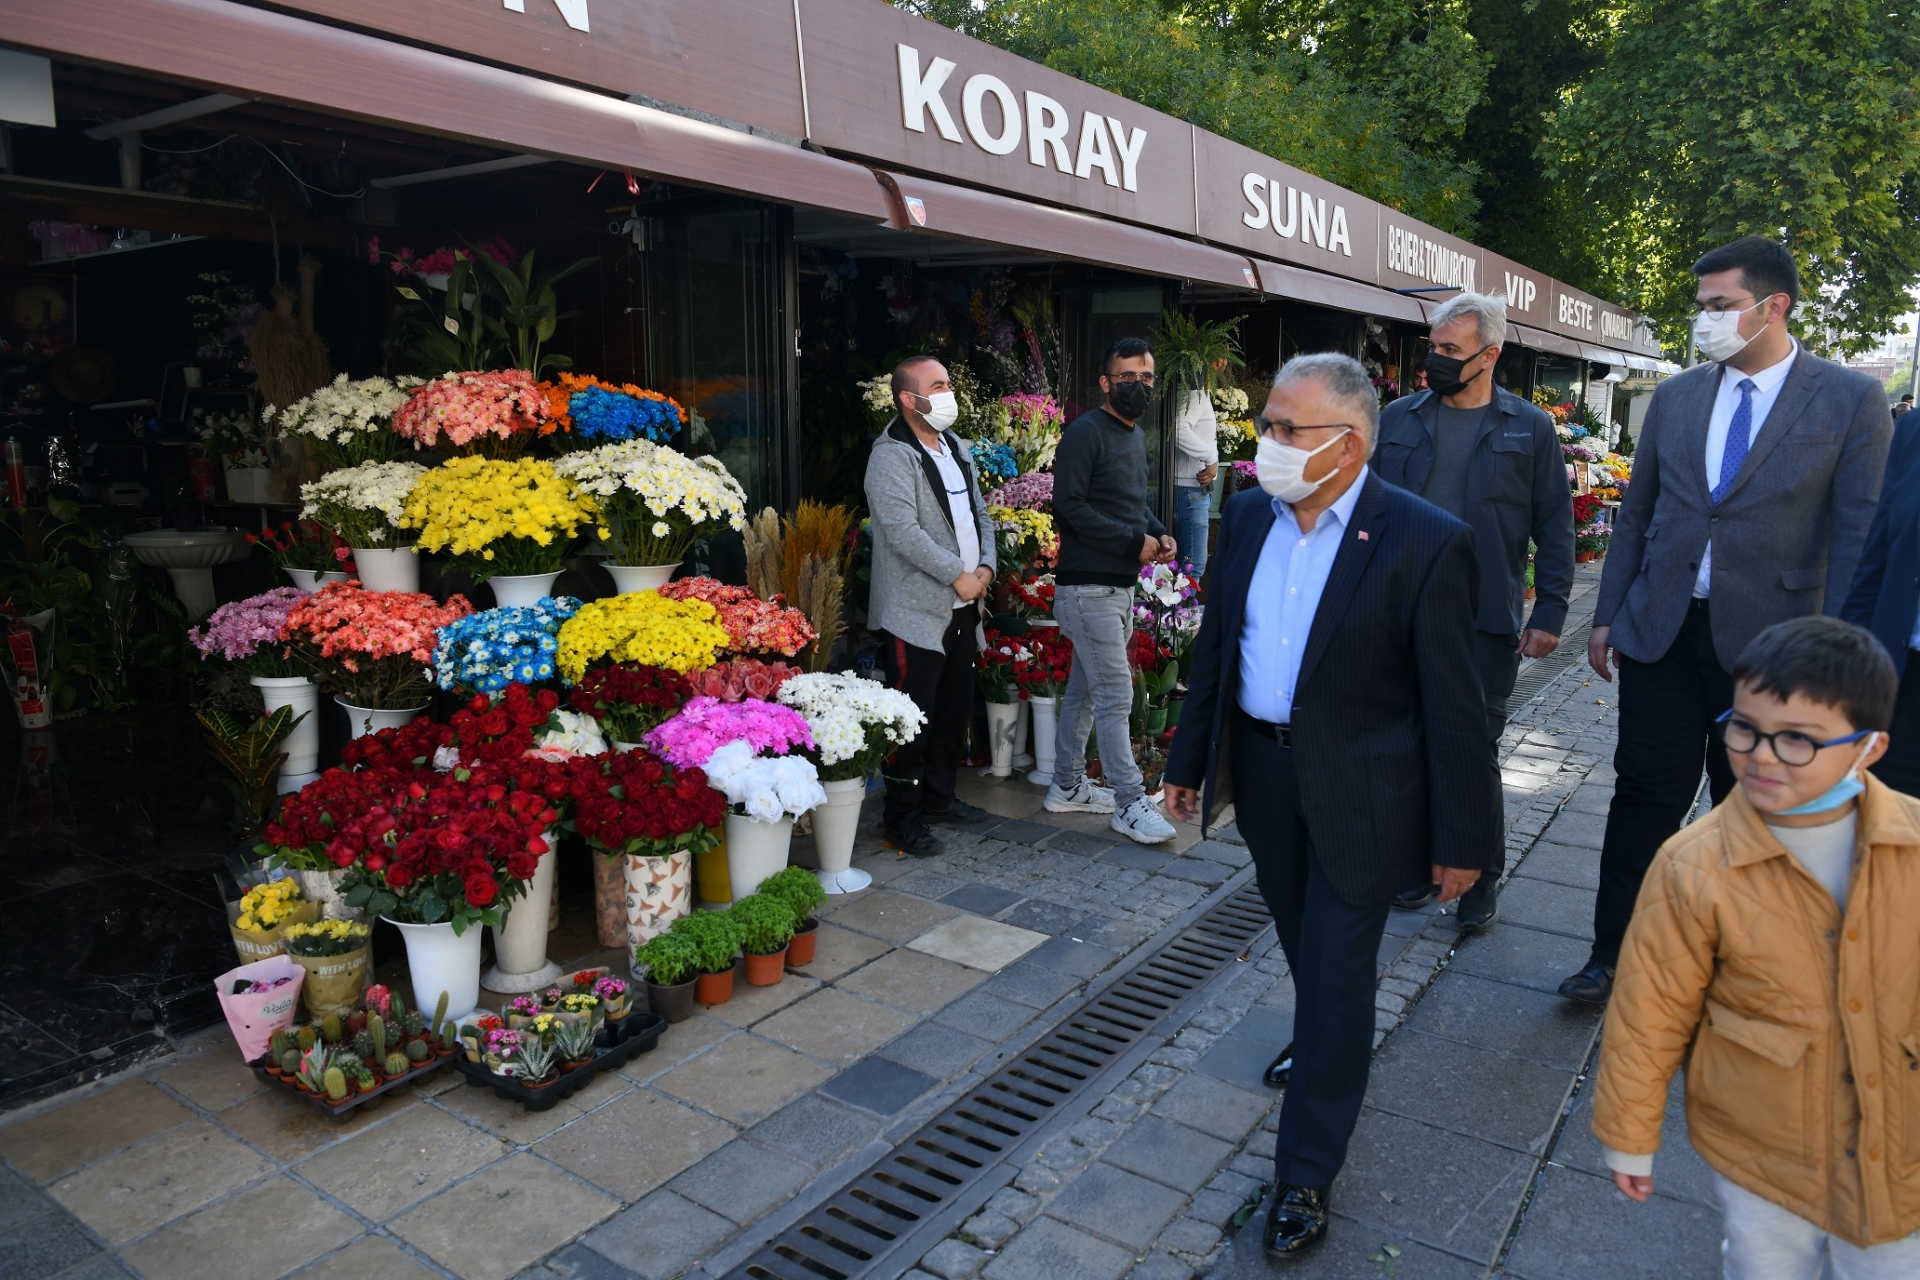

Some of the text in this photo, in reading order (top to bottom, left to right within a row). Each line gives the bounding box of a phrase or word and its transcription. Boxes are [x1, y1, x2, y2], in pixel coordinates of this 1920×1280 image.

[897, 43, 1148, 193] KORAY
[1241, 172, 1352, 257] SUNA
[1504, 271, 1537, 313] VIP
[1558, 293, 1593, 331] BESTE
[319, 963, 346, 976] WITH
